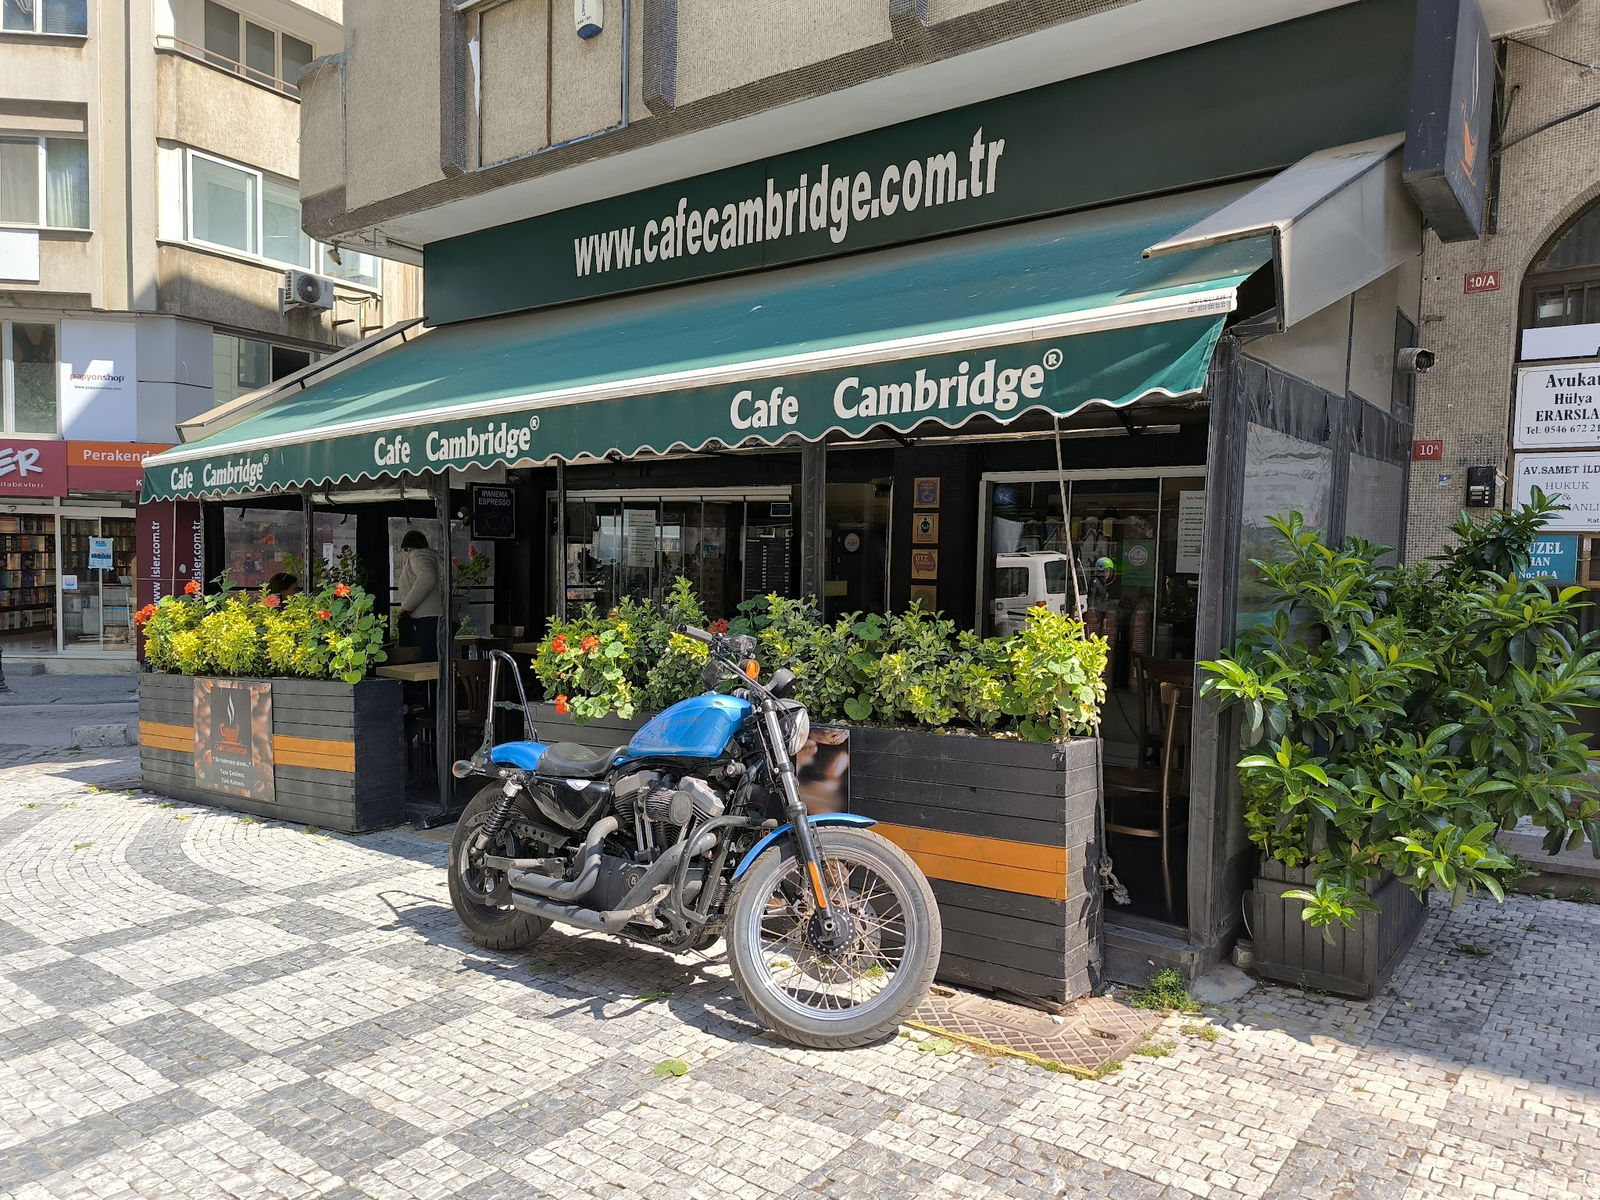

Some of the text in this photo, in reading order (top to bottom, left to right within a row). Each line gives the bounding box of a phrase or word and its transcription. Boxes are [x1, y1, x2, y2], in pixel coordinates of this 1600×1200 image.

[574, 126, 1005, 277] www.cafecambridge.com.tr
[1469, 275, 1495, 288] 10/A
[70, 373, 125, 383] papyonshop
[1554, 392, 1593, 406] Hülya
[730, 386, 799, 430] Cafe
[1535, 407, 1599, 422] ERARSLA
[1569, 424, 1587, 433] 672
[83, 449, 156, 462] Perakend
[374, 435, 411, 466] Cafe
[170, 466, 194, 490] Cafe
[1545, 481, 1590, 490] HUKUK
[481, 489, 508, 498] IPANEMA
[478, 497, 511, 506] ESPRESSO
